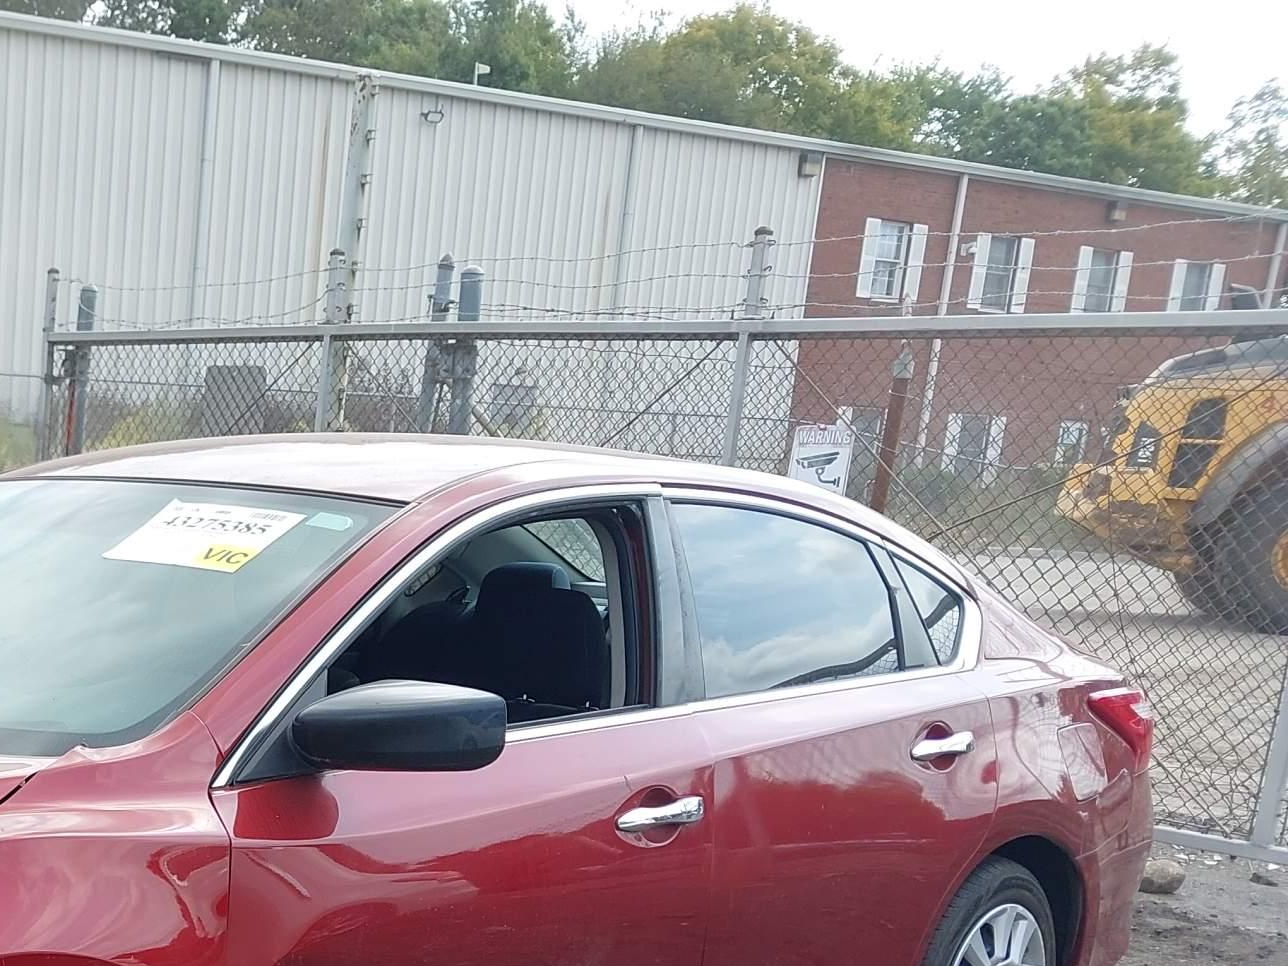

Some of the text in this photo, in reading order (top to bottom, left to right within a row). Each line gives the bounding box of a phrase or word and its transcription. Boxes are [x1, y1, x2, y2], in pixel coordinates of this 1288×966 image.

[799, 430, 852, 444] WARNING
[162, 516, 272, 535] 43275385
[203, 547, 249, 565] VIC
